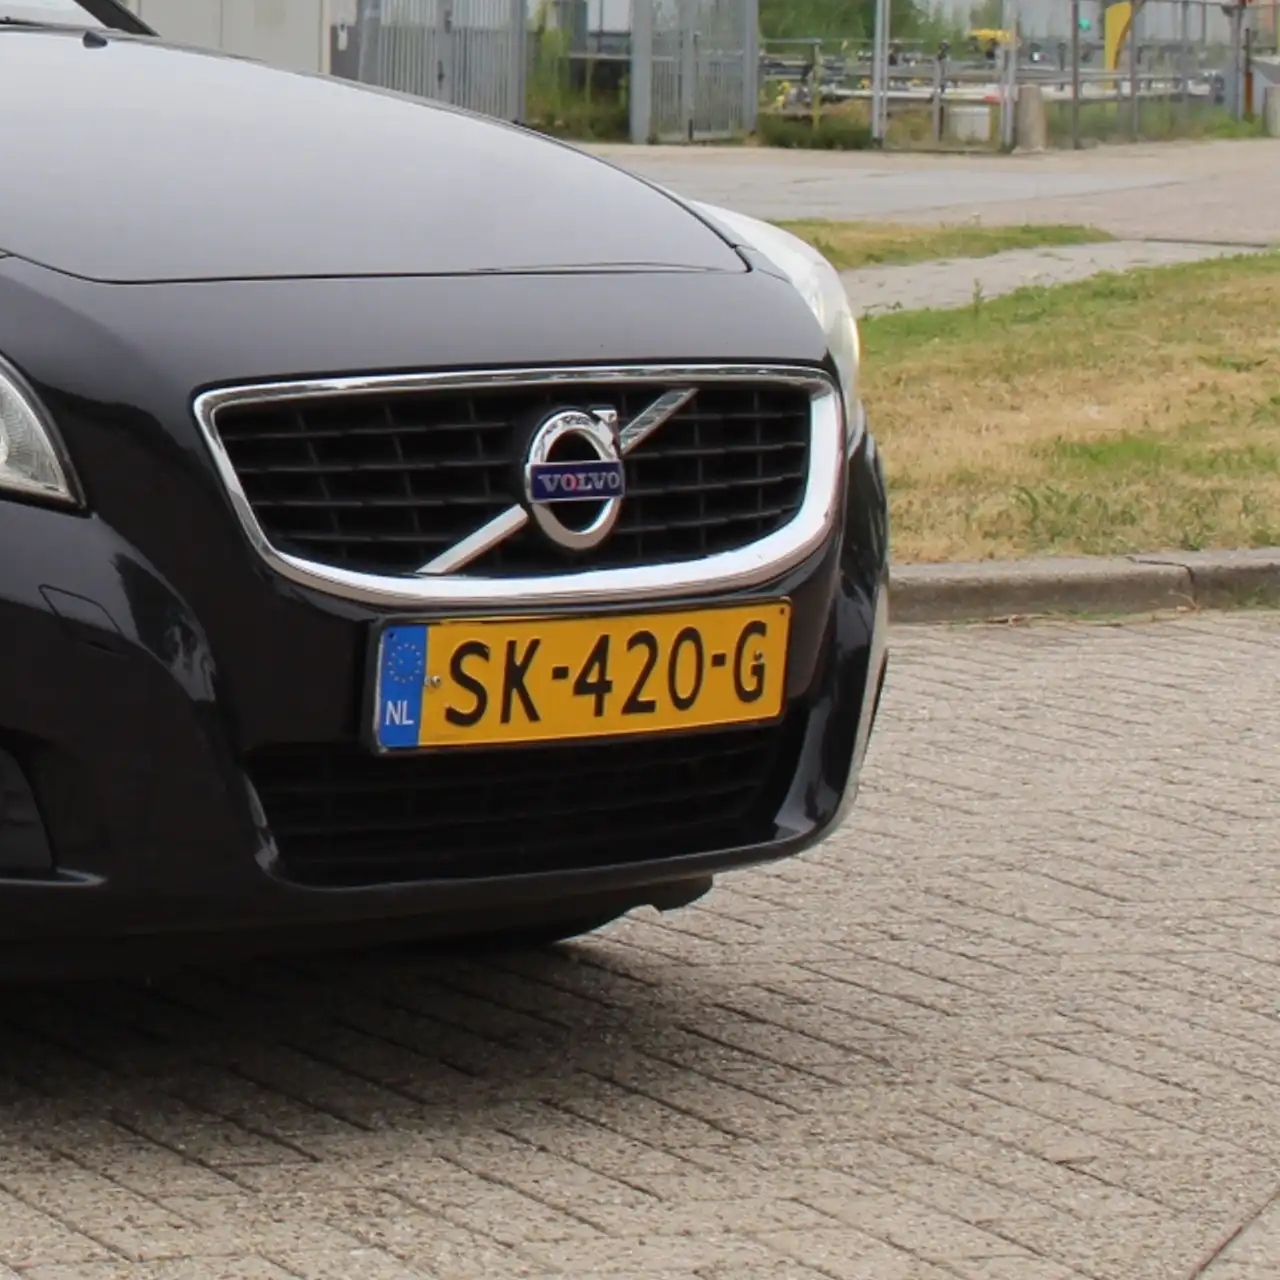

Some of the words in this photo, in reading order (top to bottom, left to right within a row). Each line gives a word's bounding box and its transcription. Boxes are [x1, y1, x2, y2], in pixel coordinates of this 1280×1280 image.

[538, 472, 621, 492] VOLVO
[445, 621, 768, 727] SK-420-G
[385, 699, 414, 725] NL
